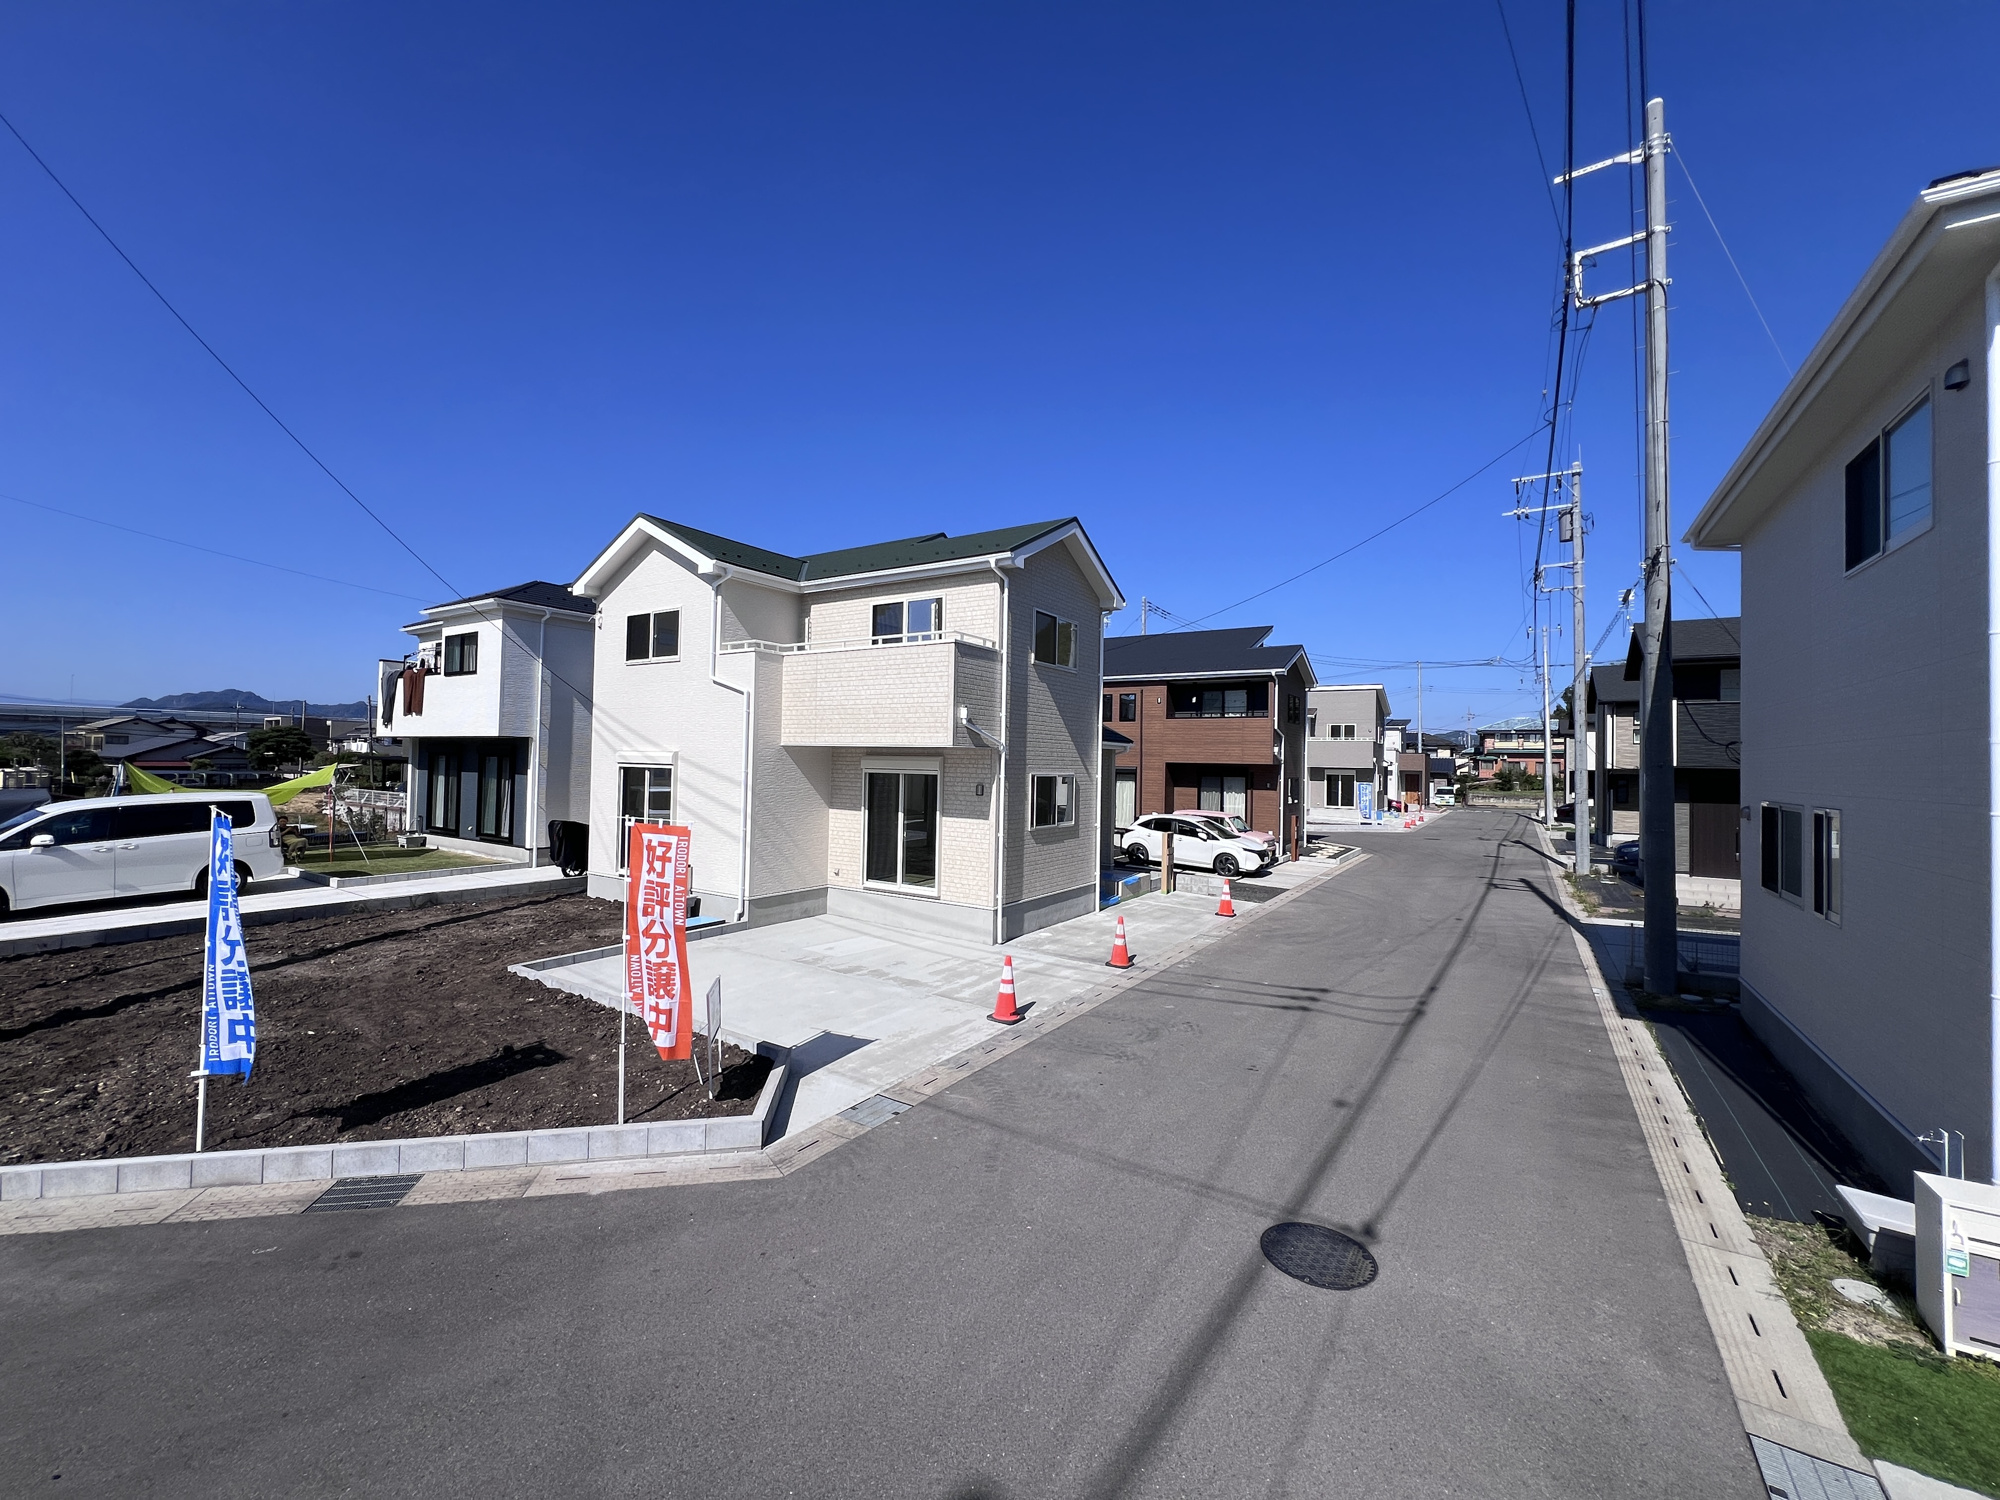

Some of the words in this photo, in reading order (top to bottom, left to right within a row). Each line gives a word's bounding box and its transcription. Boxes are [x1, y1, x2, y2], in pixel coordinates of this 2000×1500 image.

[675, 836, 689, 879] IRODORI
[674, 884, 686, 926] AiTOWN
[642, 839, 676, 1041] 好評分譲中
[630, 955, 643, 993] AiTOWN
[208, 1015, 220, 1061] IRODORI
